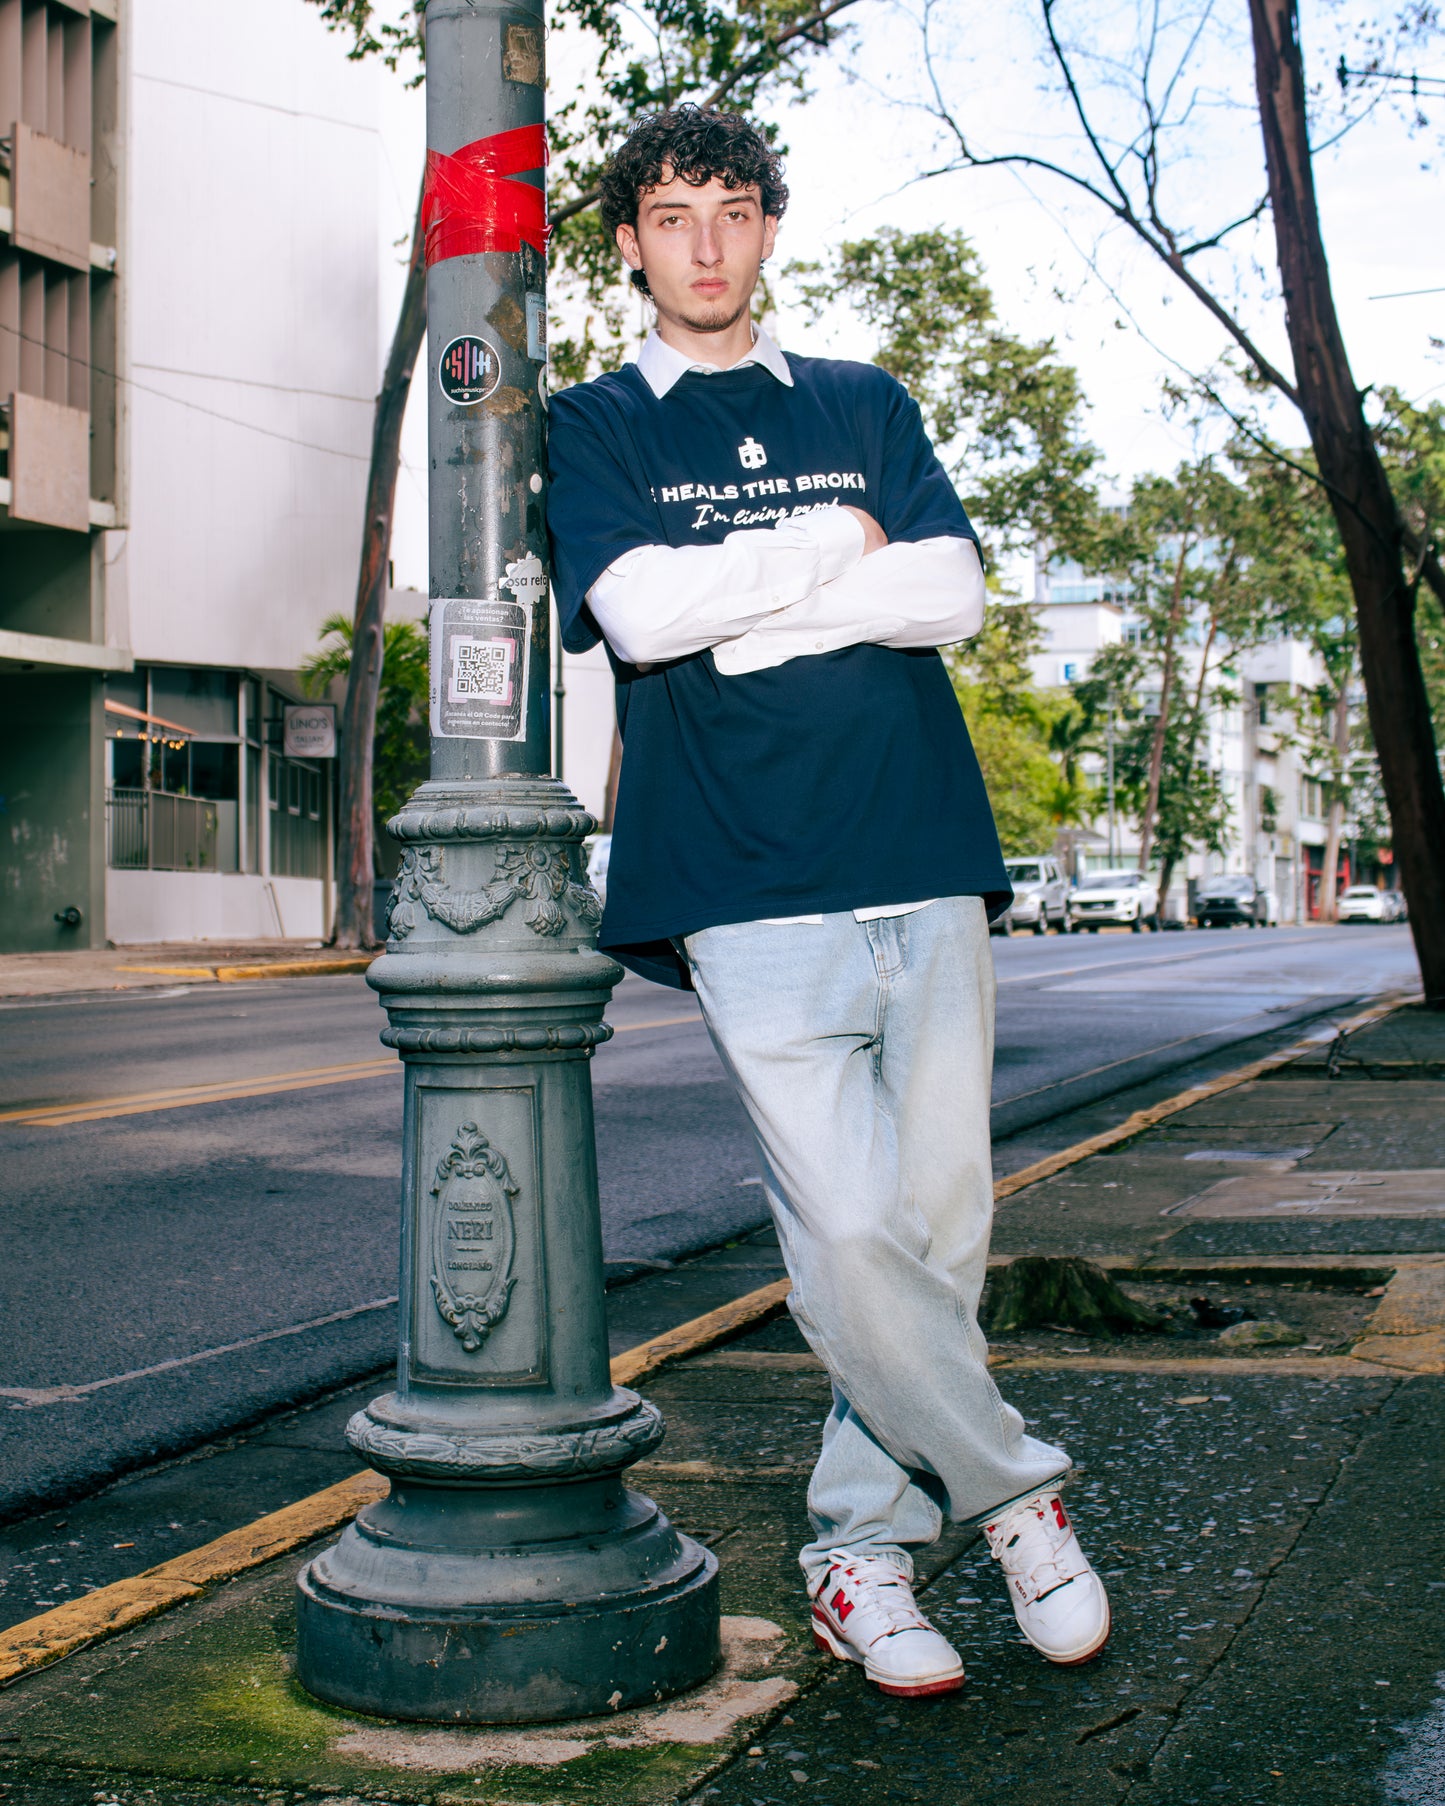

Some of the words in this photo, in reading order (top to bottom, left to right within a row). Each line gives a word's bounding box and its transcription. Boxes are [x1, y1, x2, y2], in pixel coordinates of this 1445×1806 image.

[661, 483, 739, 502] HEALS
[742, 479, 791, 499] THE
[691, 504, 730, 530] I'm
[733, 506, 789, 529] living
[290, 717, 328, 730] LINO'S
[447, 1220, 494, 1240] NERI
